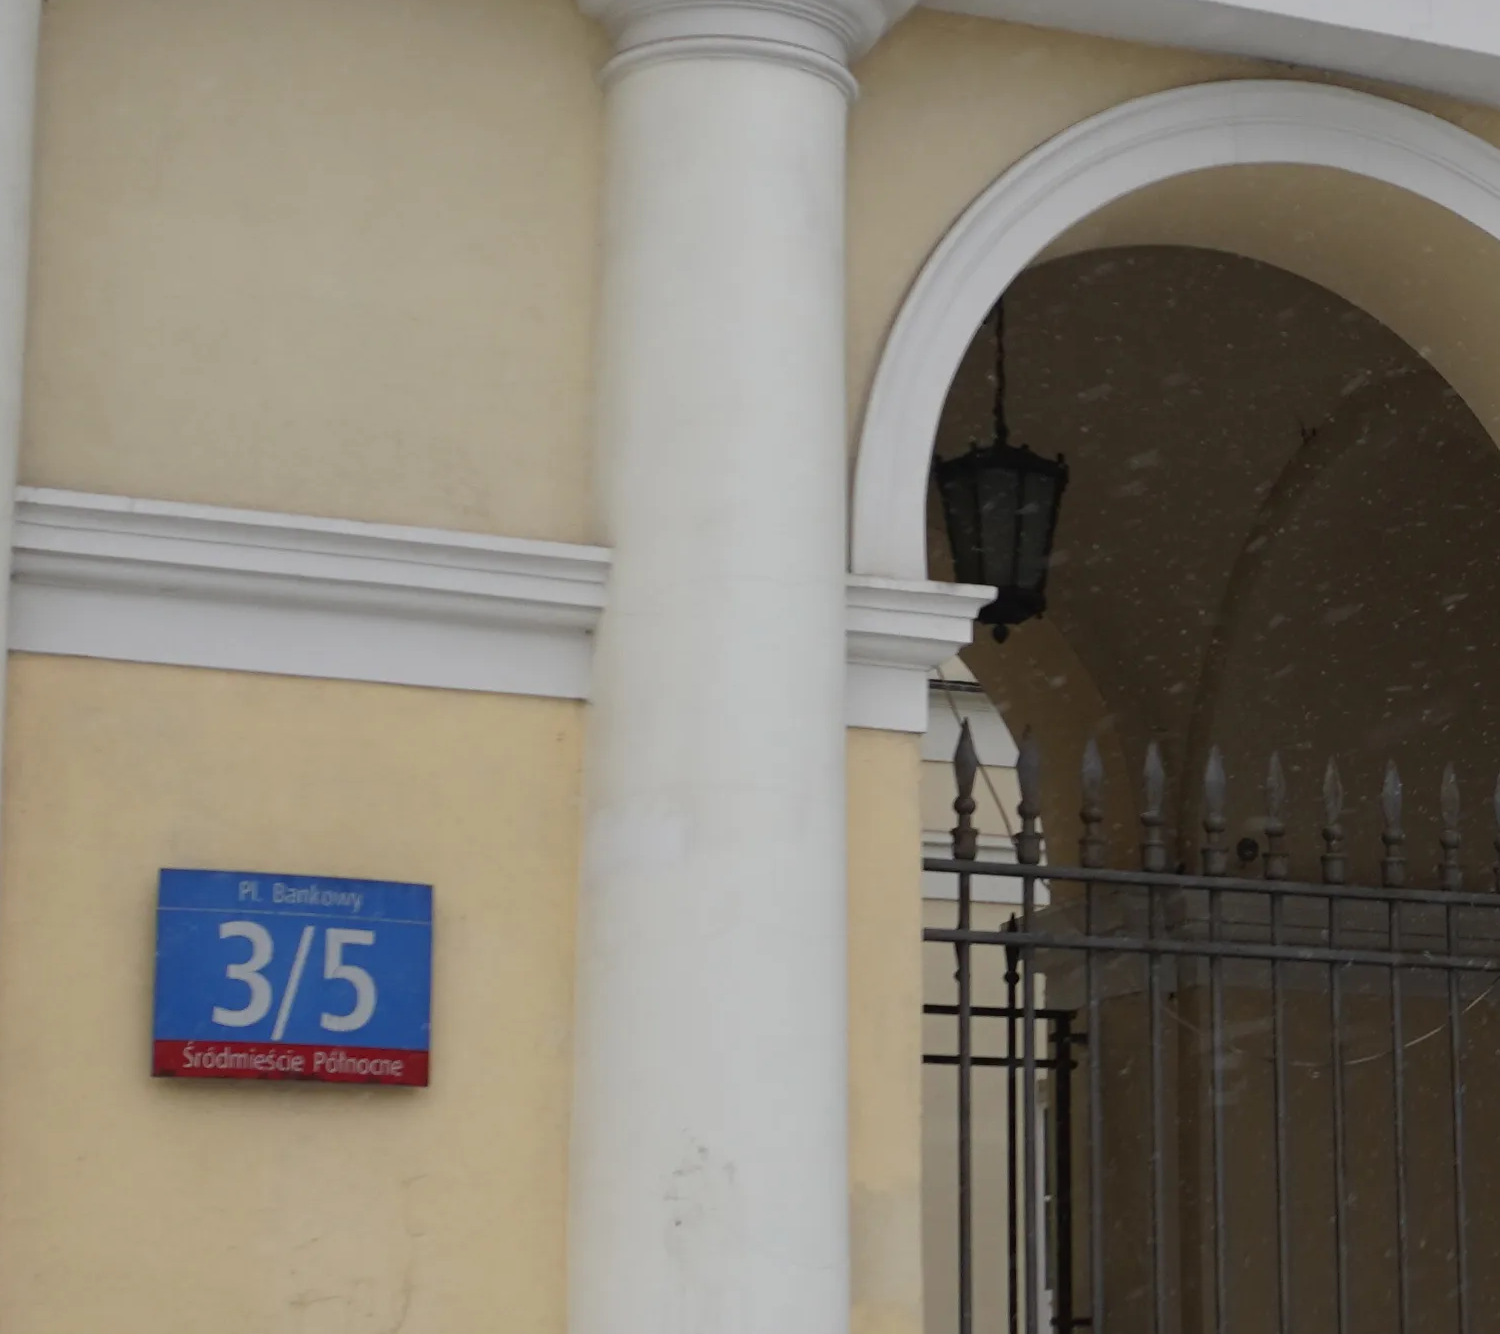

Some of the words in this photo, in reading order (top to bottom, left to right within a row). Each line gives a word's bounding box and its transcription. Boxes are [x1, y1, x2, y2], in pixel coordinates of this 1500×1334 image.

[273, 882, 363, 914] Bankowy
[212, 920, 378, 1041] 3/5
[182, 1041, 306, 1072] Śródmieście
[313, 1046, 405, 1077] Północne
